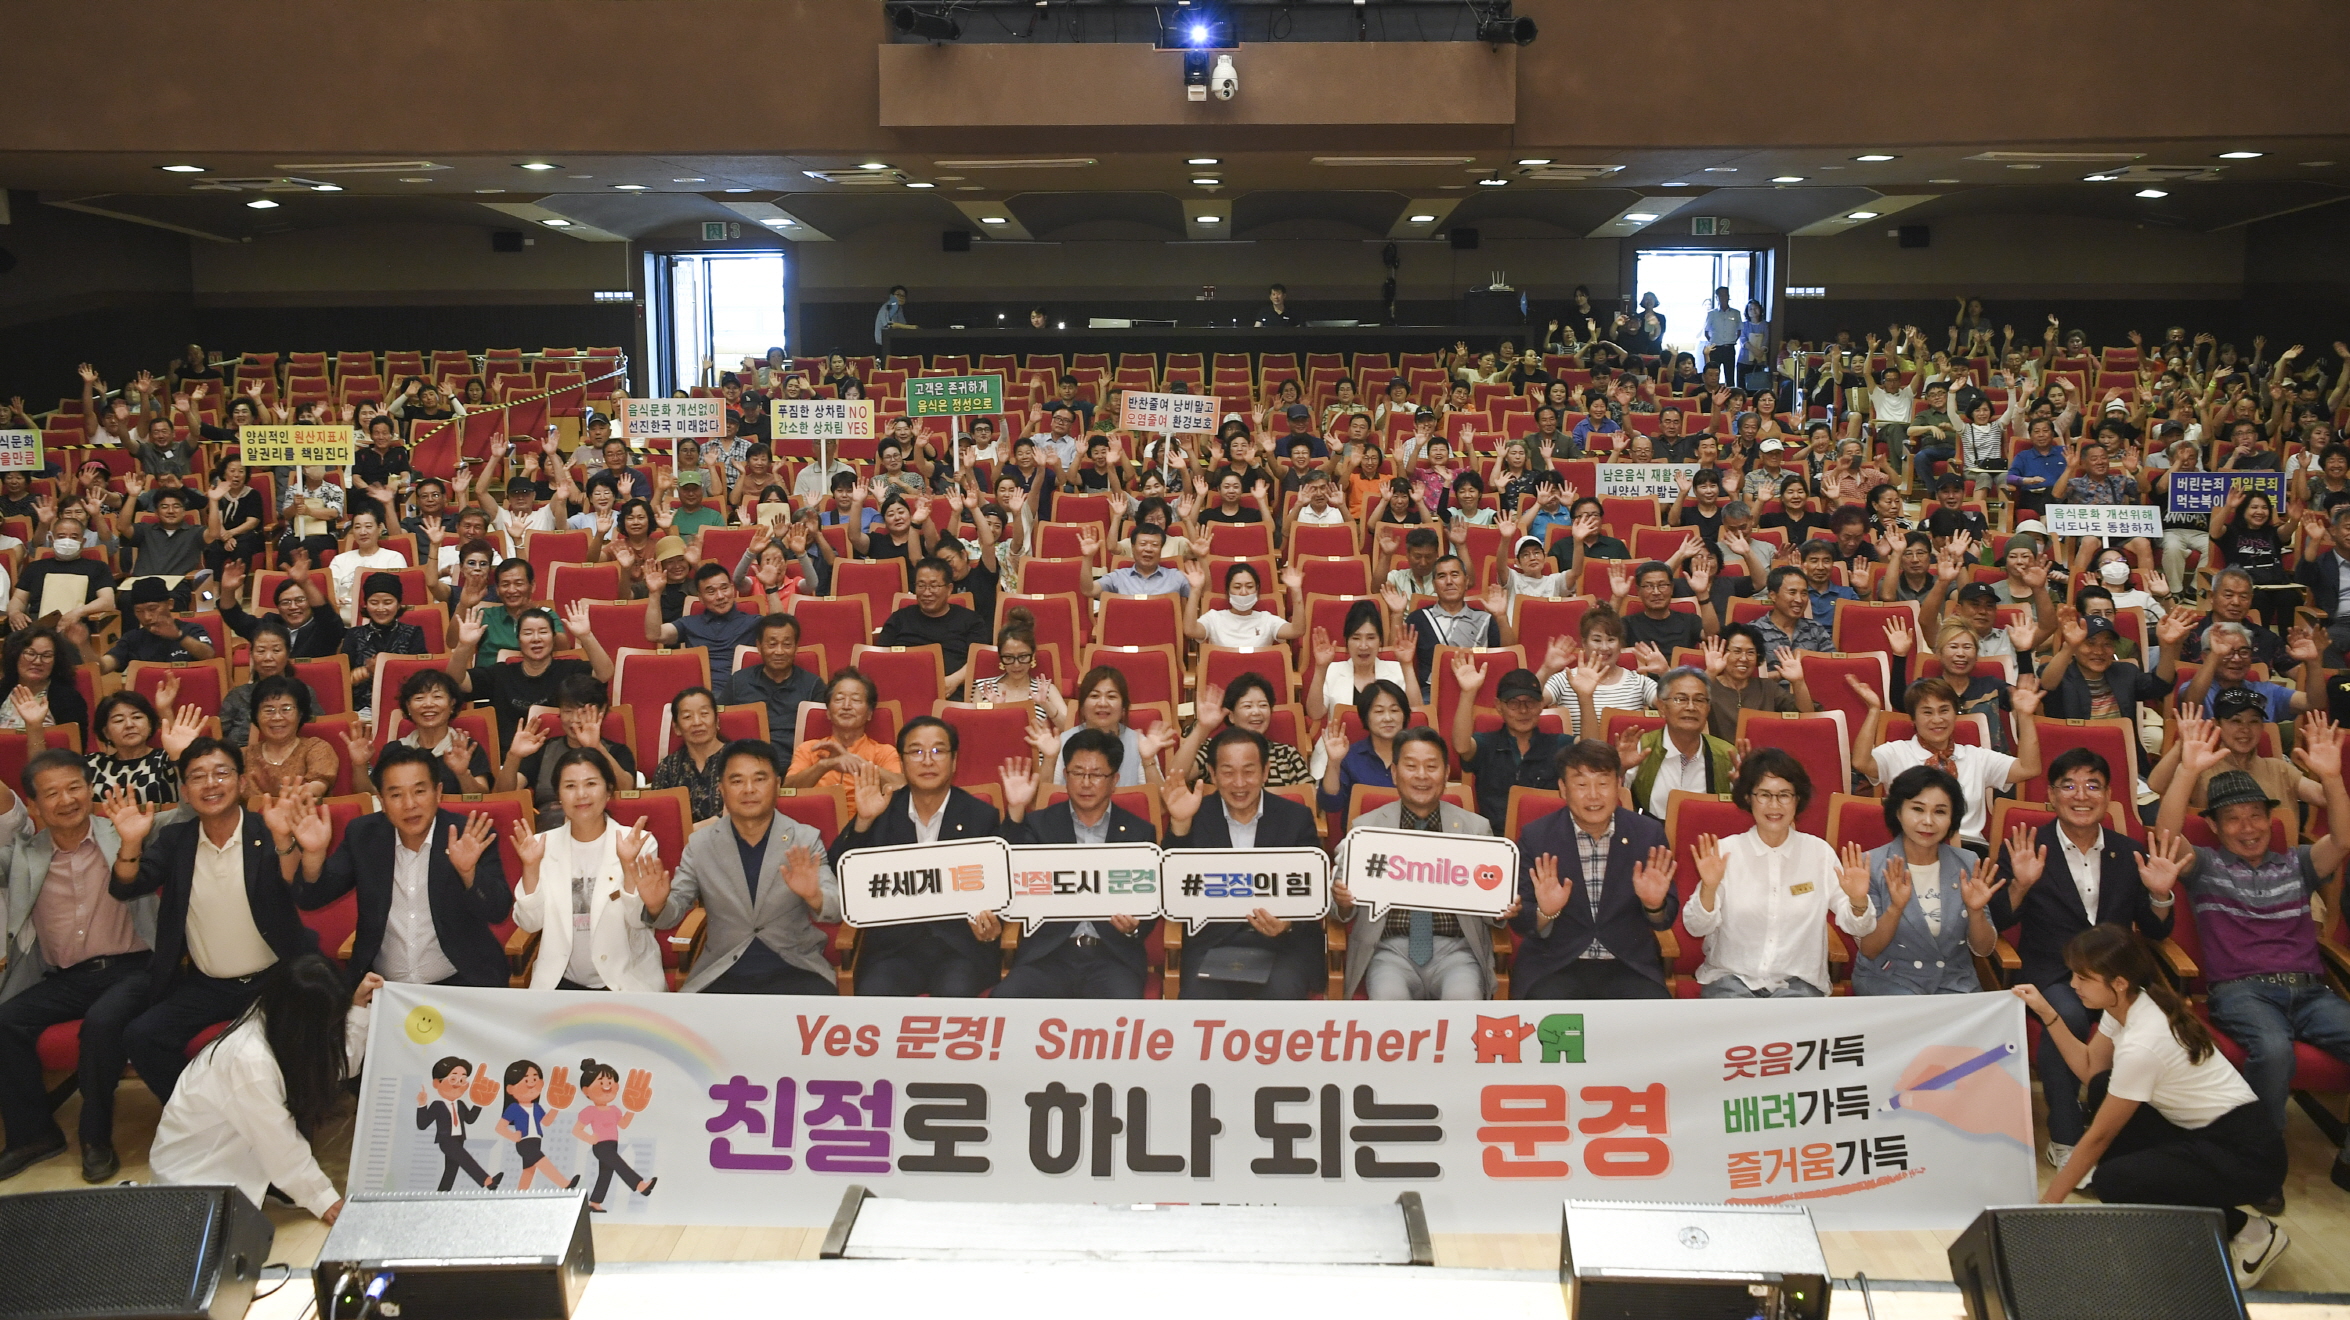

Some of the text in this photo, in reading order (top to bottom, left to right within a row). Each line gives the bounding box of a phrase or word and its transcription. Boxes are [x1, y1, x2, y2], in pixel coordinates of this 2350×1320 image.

[730, 222, 741, 239] 3
[1720, 218, 1731, 235] 2
[914, 380, 988, 396] 고객은 존귀하게
[628, 403, 719, 417] 음식문화 개선없이
[778, 405, 867, 419] 푸짐한 상차림 NO
[917, 397, 992, 413] 음식은 정성으로
[1128, 396, 1214, 414] 반찬줄여 낭비말고
[628, 419, 719, 434] 선진한국 미래없다
[778, 421, 868, 435] 간소한 상차림 YES
[1126, 413, 1212, 429] 오염줄여 환경보호
[246, 430, 348, 444] 양심적인 원산지표시
[247, 447, 348, 461] 알권리를 책임진다
[1603, 468, 1645, 482] 남은음식
[2176, 494, 2224, 508] 먹는복이
[2054, 508, 2153, 520] 음식문화 개선위해
[2055, 521, 2154, 534] 너도나도 동참하자
[1365, 853, 1470, 887] #Smile
[868, 864, 985, 898] #세계 1등
[1107, 869, 1156, 895] 문경
[1181, 872, 1312, 897] #긍정의 힘
[796, 1015, 1449, 1065] Yes 문경! Smile Together!
[1722, 1034, 1865, 1081] 웃음가득
[1723, 1085, 1870, 1133] 배려가득
[705, 1075, 1673, 1180] 친절로 하나 되는 문경
[1727, 1135, 1908, 1190] 즐거움가득
